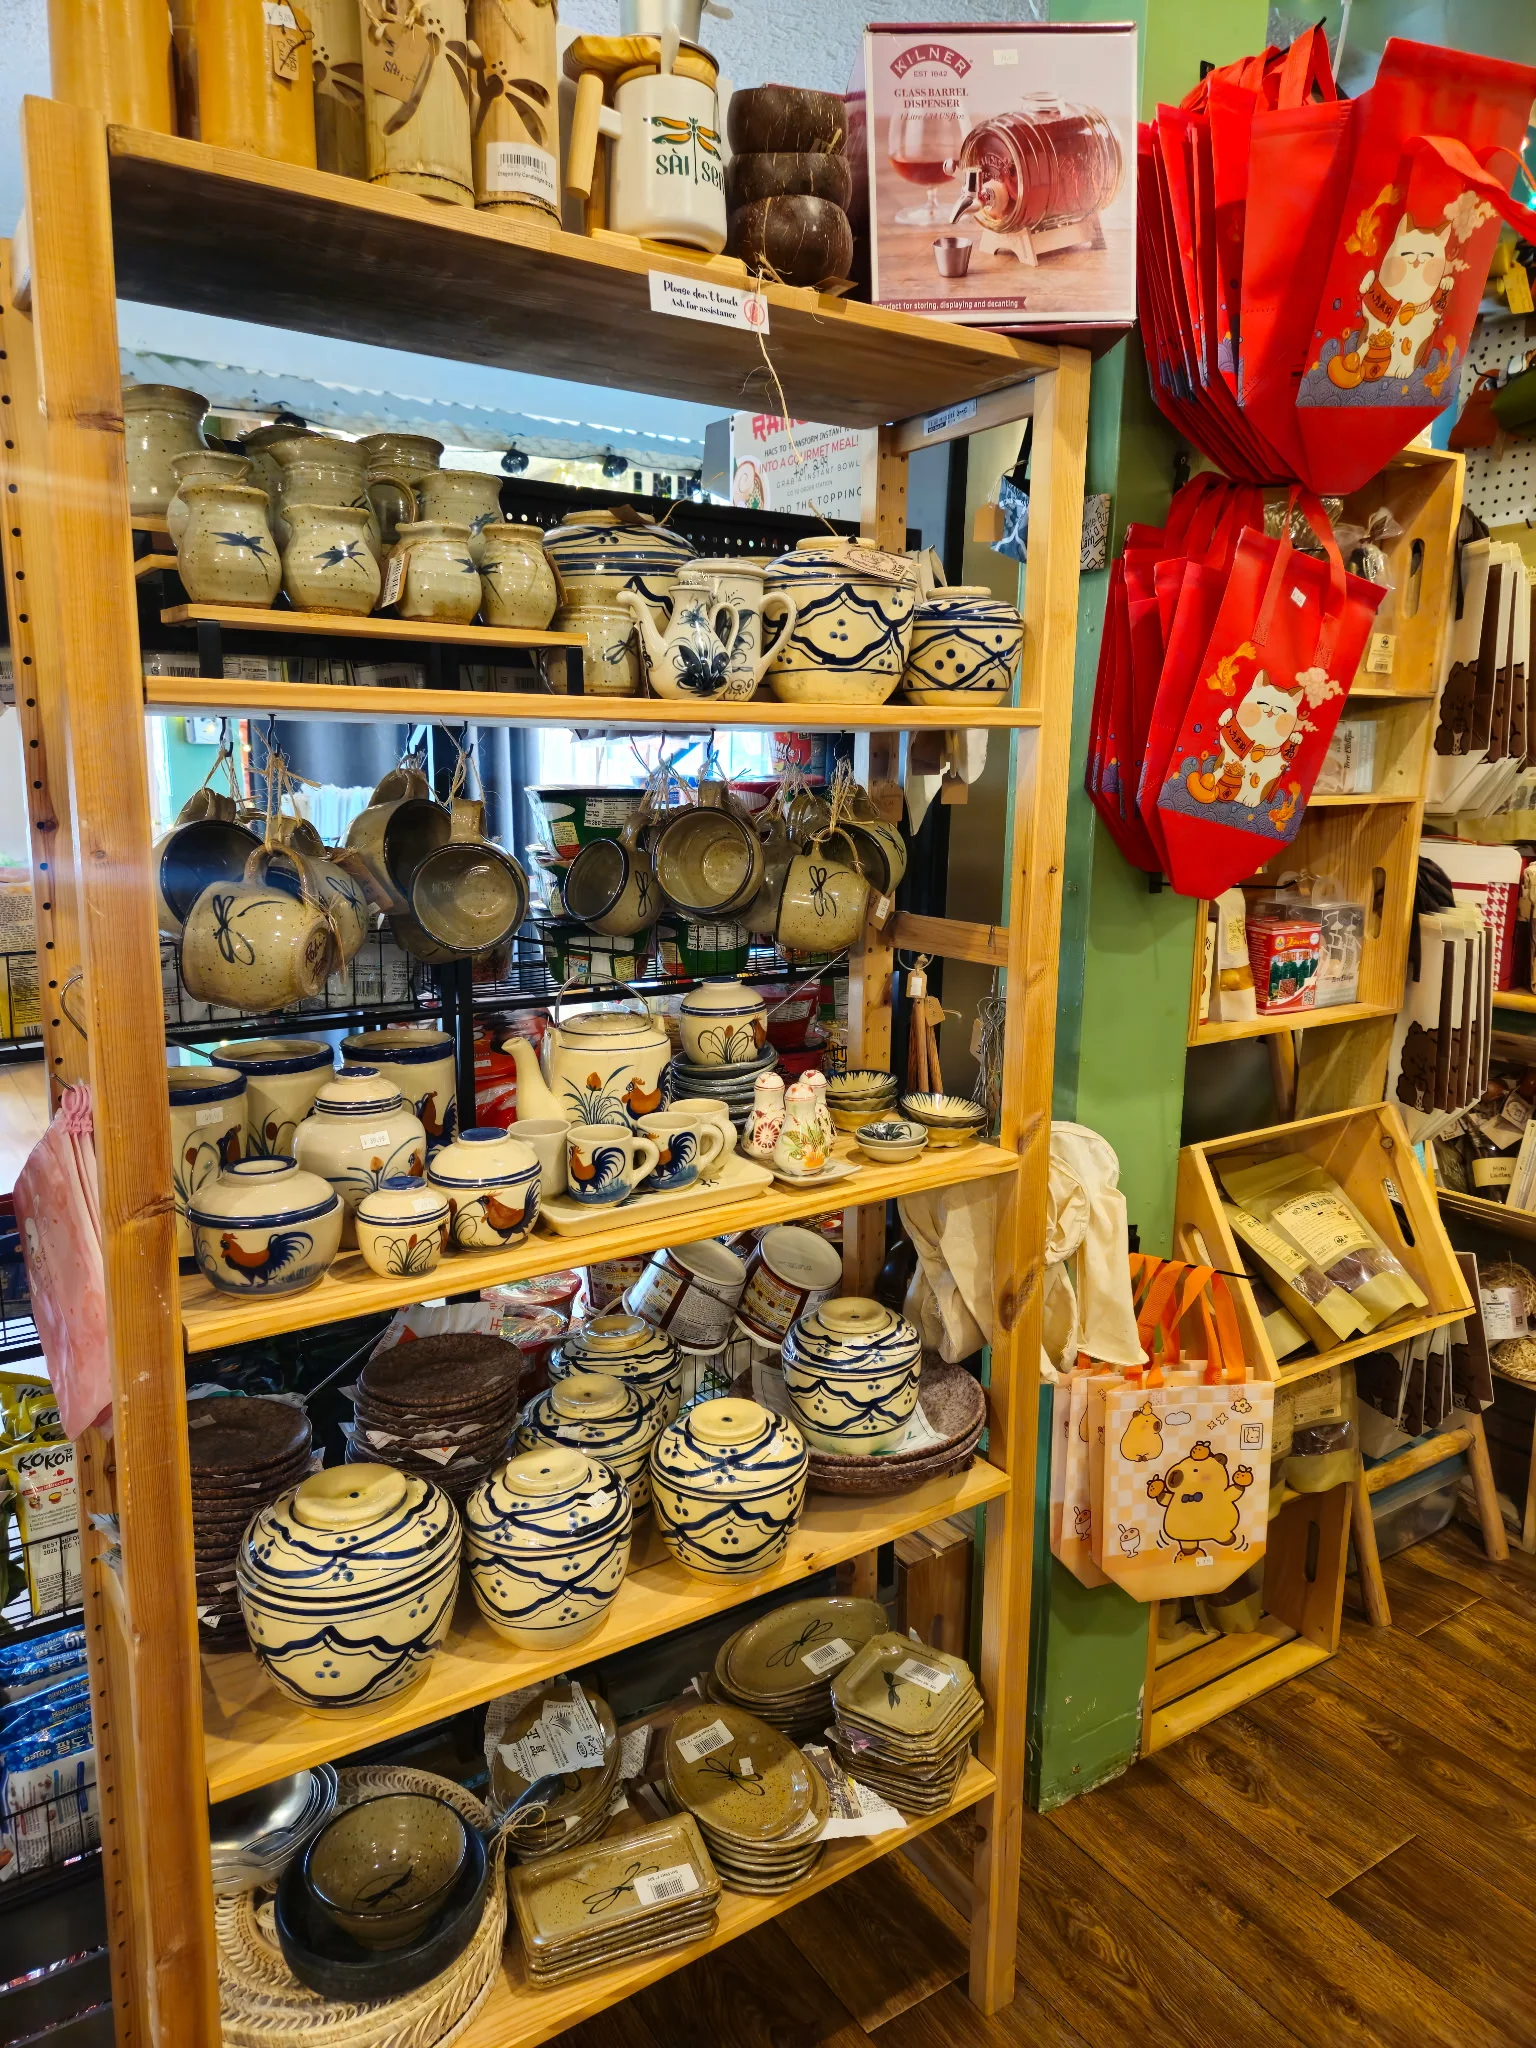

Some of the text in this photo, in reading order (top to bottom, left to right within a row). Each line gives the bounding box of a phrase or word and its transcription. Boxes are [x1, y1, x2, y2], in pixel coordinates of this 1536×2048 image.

[894, 47, 967, 74] KILNER
[931, 70, 948, 78] 1842
[894, 87, 969, 98] GLASS BARREL
[903, 99, 960, 109] DISPENSER
[655, 148, 690, 176] SÀI
[663, 280, 739, 307] Please don't touch
[671, 298, 737, 319] Ask for assistance
[903, 302, 912, 310] for
[913, 300, 939, 310] storing,
[940, 299, 973, 310] displaying
[973, 300, 986, 308] and
[987, 299, 1018, 308] decanting
[779, 444, 787, 453] TO
[780, 458, 786, 468] A
[831, 435, 860, 453] MEAL!
[776, 477, 795, 489] GRAB
[804, 466, 834, 481] INSTANT
[837, 460, 861, 472] BOWL
[42, 1541, 58, 1550] BEST
